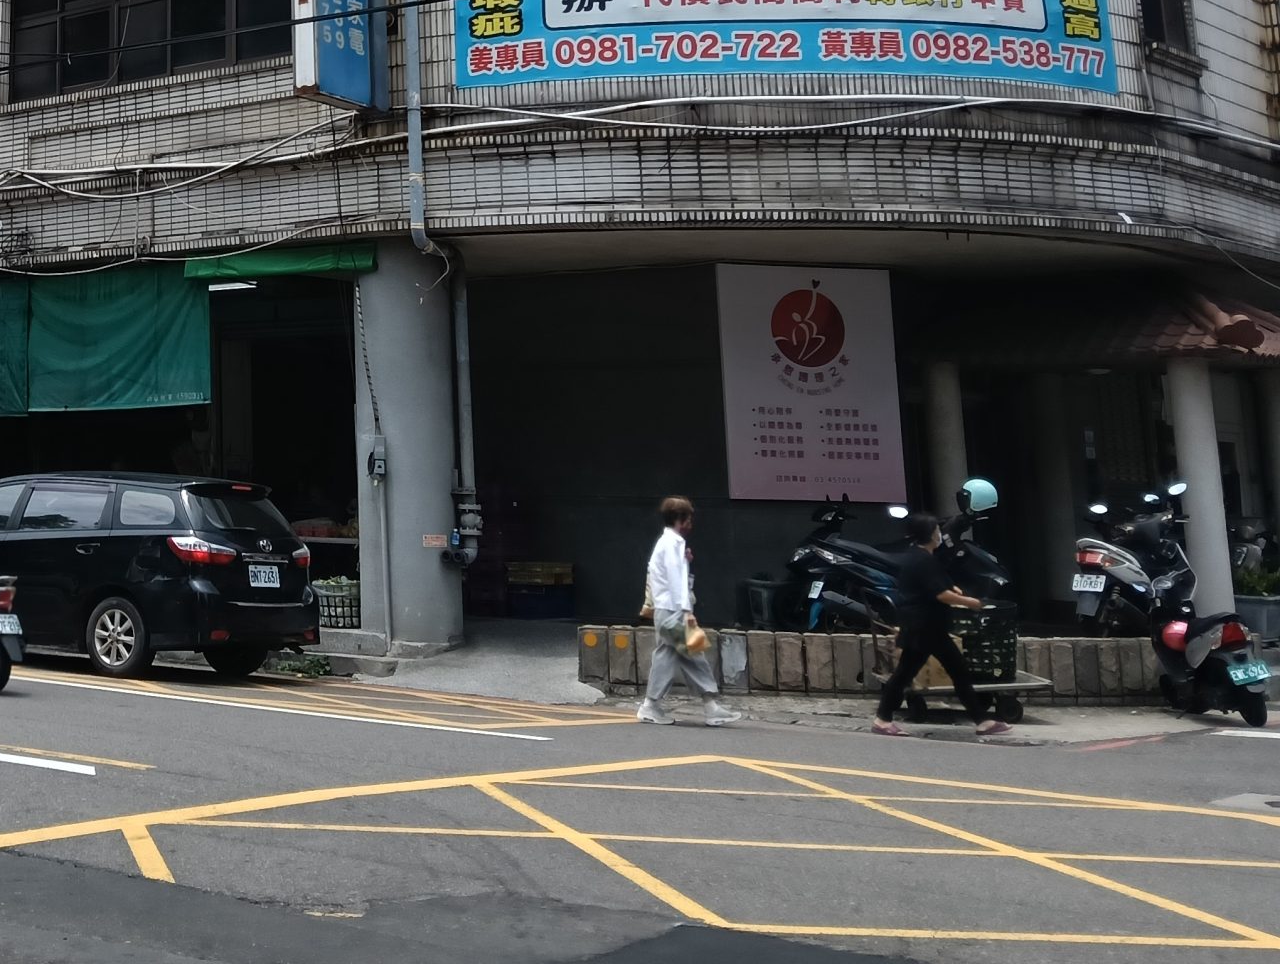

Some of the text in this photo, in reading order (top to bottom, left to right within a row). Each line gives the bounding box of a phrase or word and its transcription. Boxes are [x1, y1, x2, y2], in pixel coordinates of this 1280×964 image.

[469, 30, 1106, 76] 姜專員 0981-702-722 黃專員 0982-538-777
